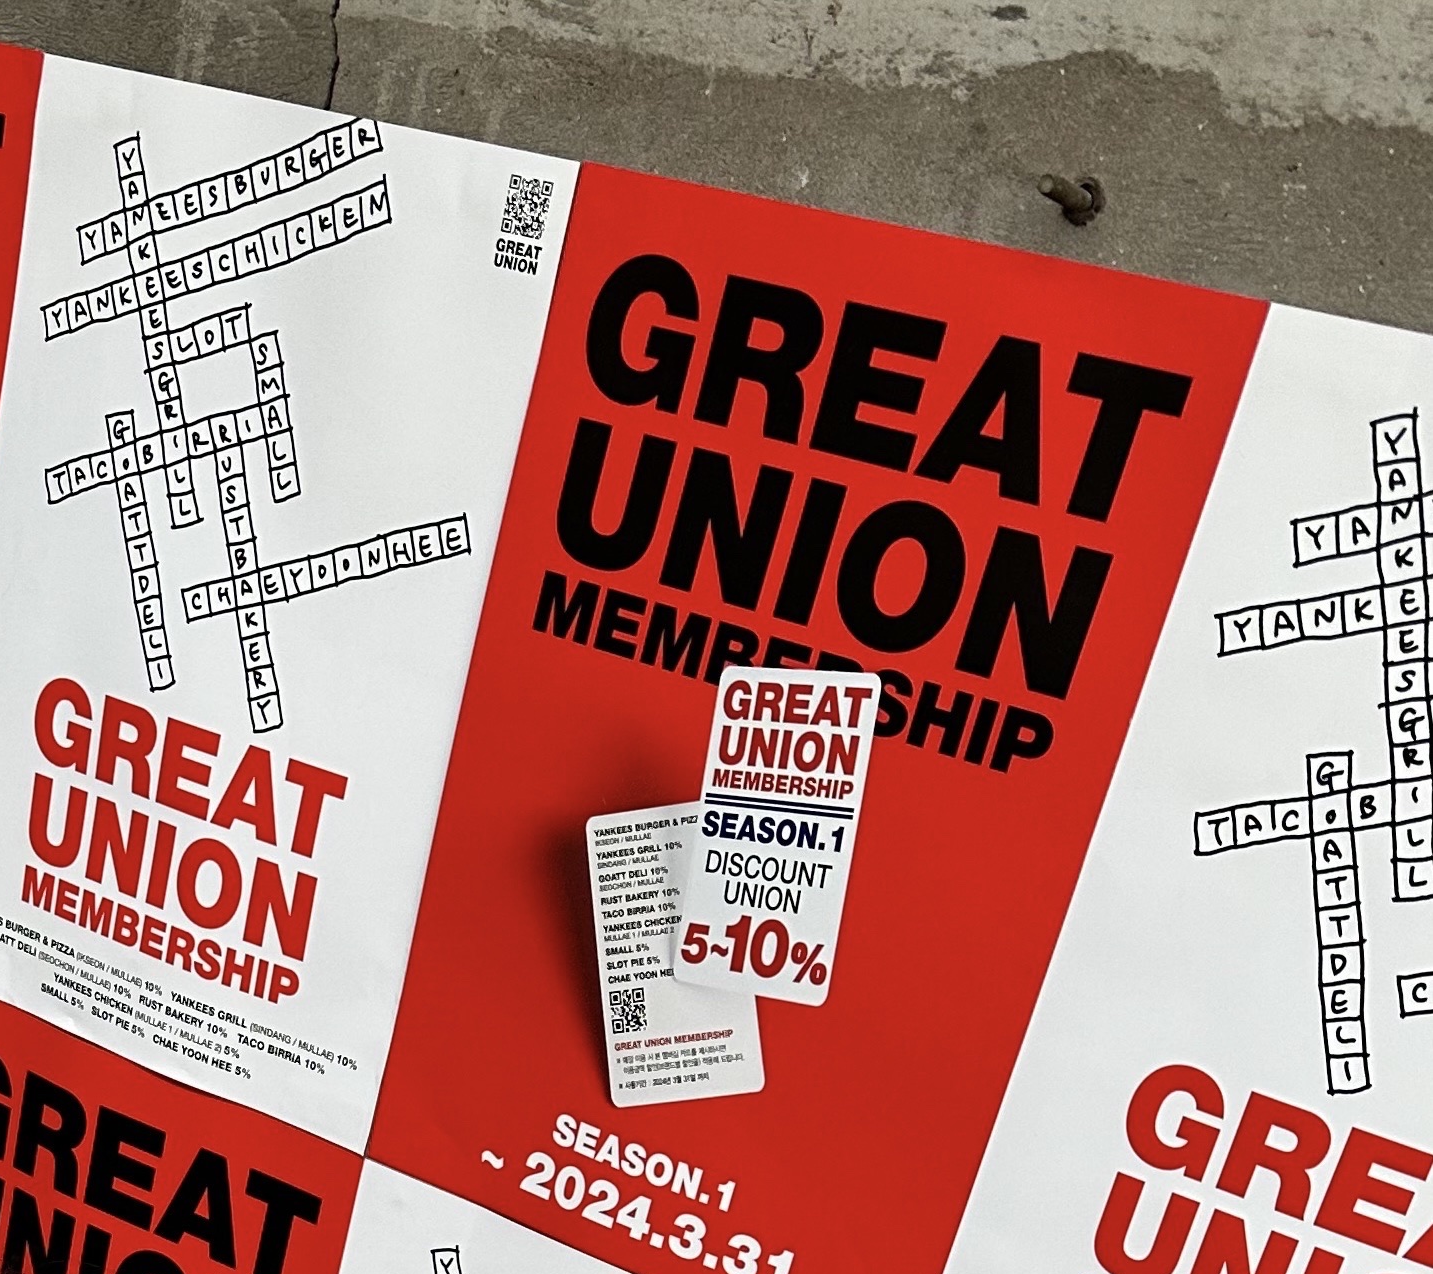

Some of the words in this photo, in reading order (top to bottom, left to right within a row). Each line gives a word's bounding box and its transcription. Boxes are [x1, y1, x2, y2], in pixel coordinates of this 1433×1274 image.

[493, 252, 538, 276] UNION
[495, 237, 543, 260] GREAT
[586, 253, 1193, 523] GREAT
[556, 416, 1114, 700] UNION
[722, 680, 873, 729] GREAT
[34, 677, 349, 859] GREAT
[718, 725, 861, 776] UNION
[712, 768, 854, 801] MEMBERSHIP
[28, 772, 318, 962] UNION
[705, 849, 834, 889] DISCOUNT
[723, 880, 802, 914] UNION
[21, 864, 299, 1004] MEMBERSHIP
[5, 919, 41, 943] BURGER
[42, 936, 49, 946] &
[50, 939, 75, 958] PIZZA
[144, 981, 163, 996] 10%
[171, 991, 215, 1017] YANKEES
[217, 1010, 247, 1029] GRILL
[337, 1055, 358, 1071] 10%
[139, 994, 164, 1012] RUST
[165, 1005, 204, 1029] BAKERY
[207, 1023, 228, 1038] 10%
[237, 1033, 265, 1051] TACO
[267, 1044, 301, 1066] BIRRIA
[305, 1059, 325, 1075] 10%
[152, 1034, 179, 1053] CHAE
[181, 1045, 209, 1064] YOON
[211, 1057, 232, 1073] HEE
[234, 1065, 251, 1079] 5%
